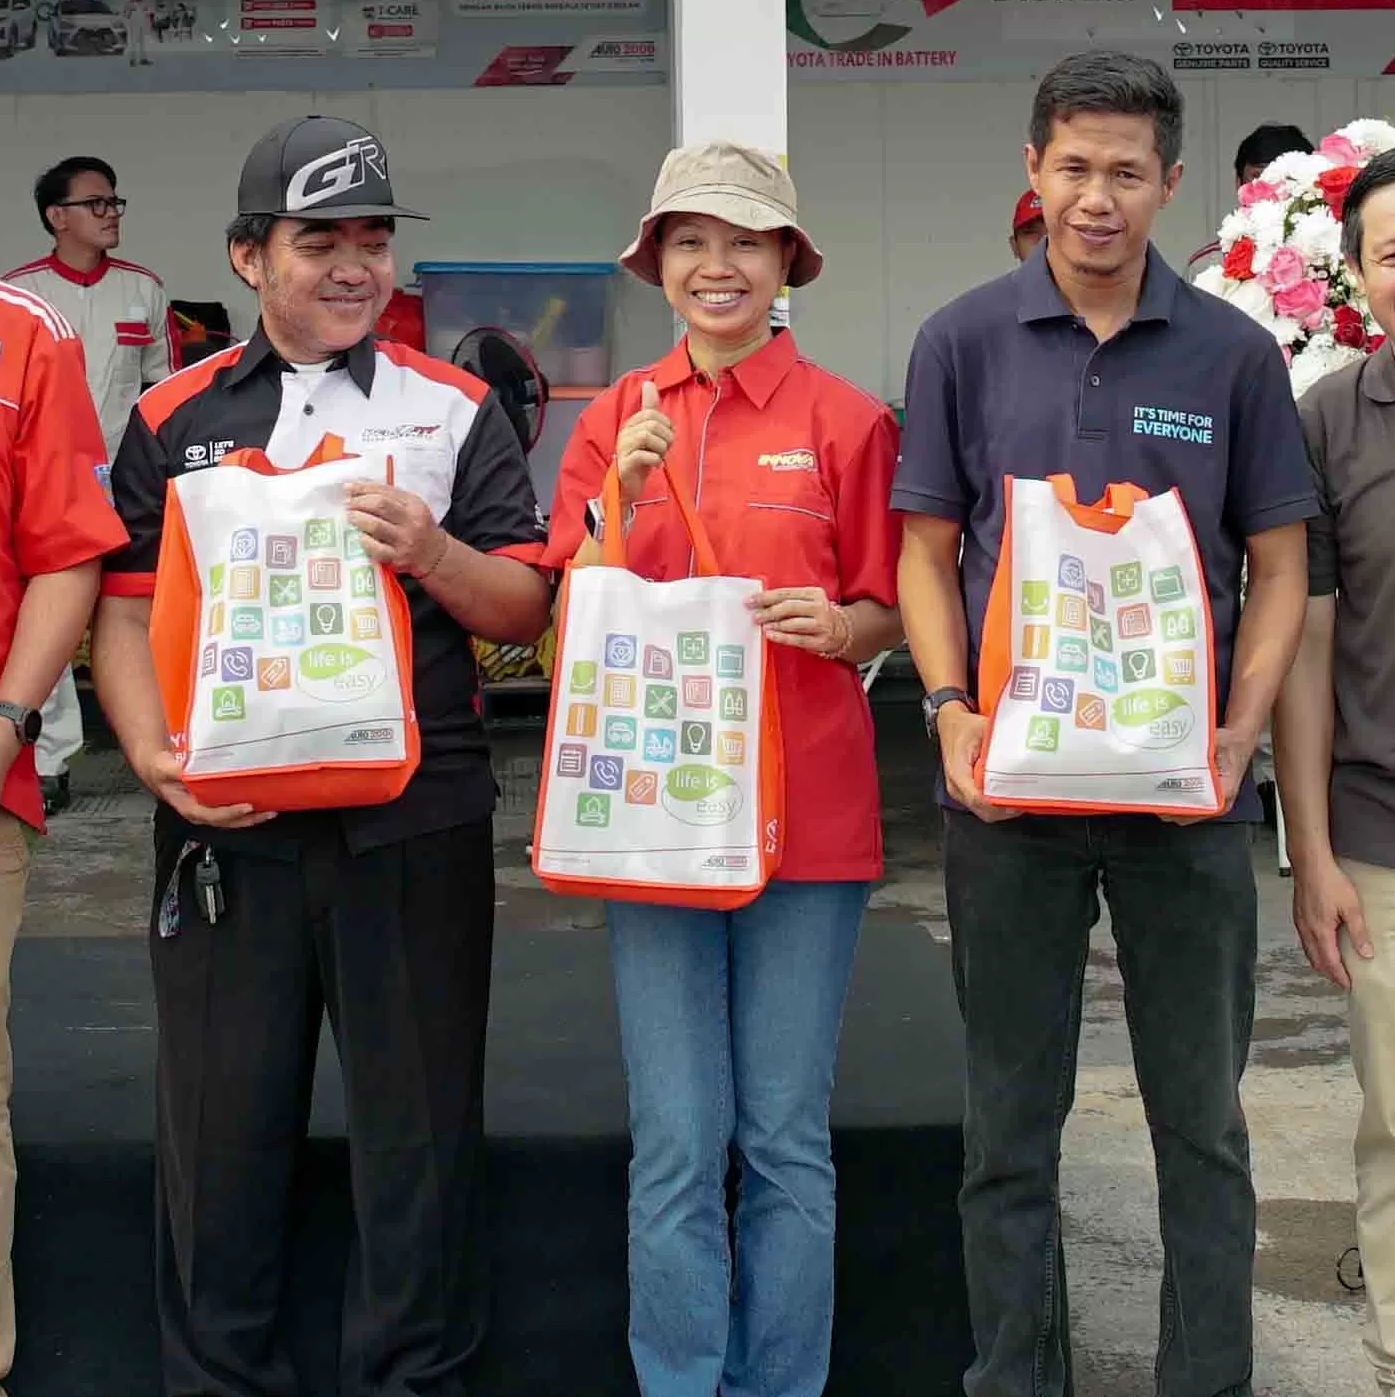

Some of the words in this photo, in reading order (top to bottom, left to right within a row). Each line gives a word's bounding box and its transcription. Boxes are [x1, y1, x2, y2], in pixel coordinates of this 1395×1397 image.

[1195, 43, 1250, 55] TOYOTA
[1278, 42, 1329, 54] TOYOTA
[787, 52, 826, 68] YOTA
[829, 50, 874, 67] TRADE
[896, 50, 957, 67] BATTERY
[1133, 406, 1156, 420] IT'S
[1157, 408, 1187, 424] TIME
[1187, 413, 1213, 429] FOR
[1133, 418, 1213, 444] EVERYONE
[309, 650, 336, 668] life
[1121, 697, 1150, 716] life
[1154, 697, 1168, 712] is
[1149, 719, 1188, 741] easy
[675, 768, 698, 789] life
